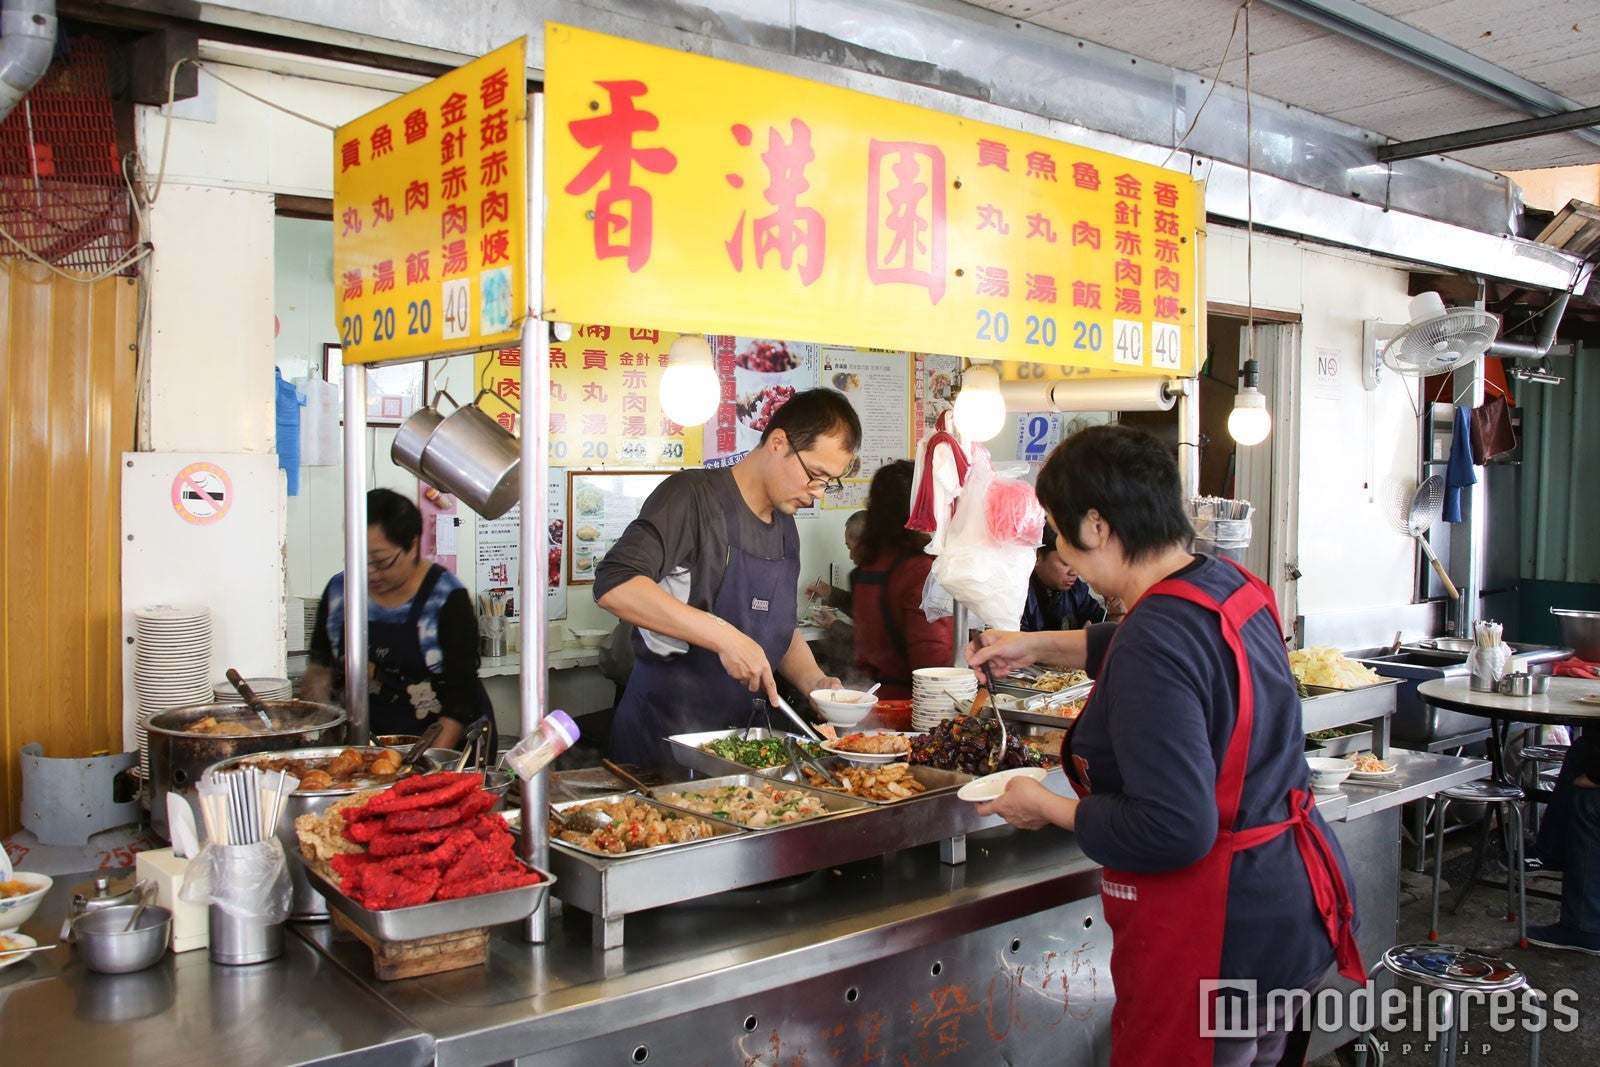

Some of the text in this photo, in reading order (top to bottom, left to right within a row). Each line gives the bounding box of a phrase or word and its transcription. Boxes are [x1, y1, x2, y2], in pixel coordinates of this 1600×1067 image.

[341, 137, 363, 347] 貢丸湯 20
[370, 123, 396, 342] 魚丸湯 20
[403, 107, 432, 336] 魯肉飯 20
[440, 91, 468, 335] 金針赤肉湯 40
[564, 79, 947, 306] 香滿園
[976, 138, 1010, 343] 貢丸湯 20
[1025, 150, 1058, 347] 魚丸湯 20
[1071, 161, 1102, 310] 魯肉飯
[1113, 173, 1142, 361] 金針赤肉湯 40
[582, 349, 609, 459] 貢丸湯 20
[1073, 320, 1102, 352] 20
[1155, 327, 1178, 364] 40
[1025, 417, 1048, 453] 2
